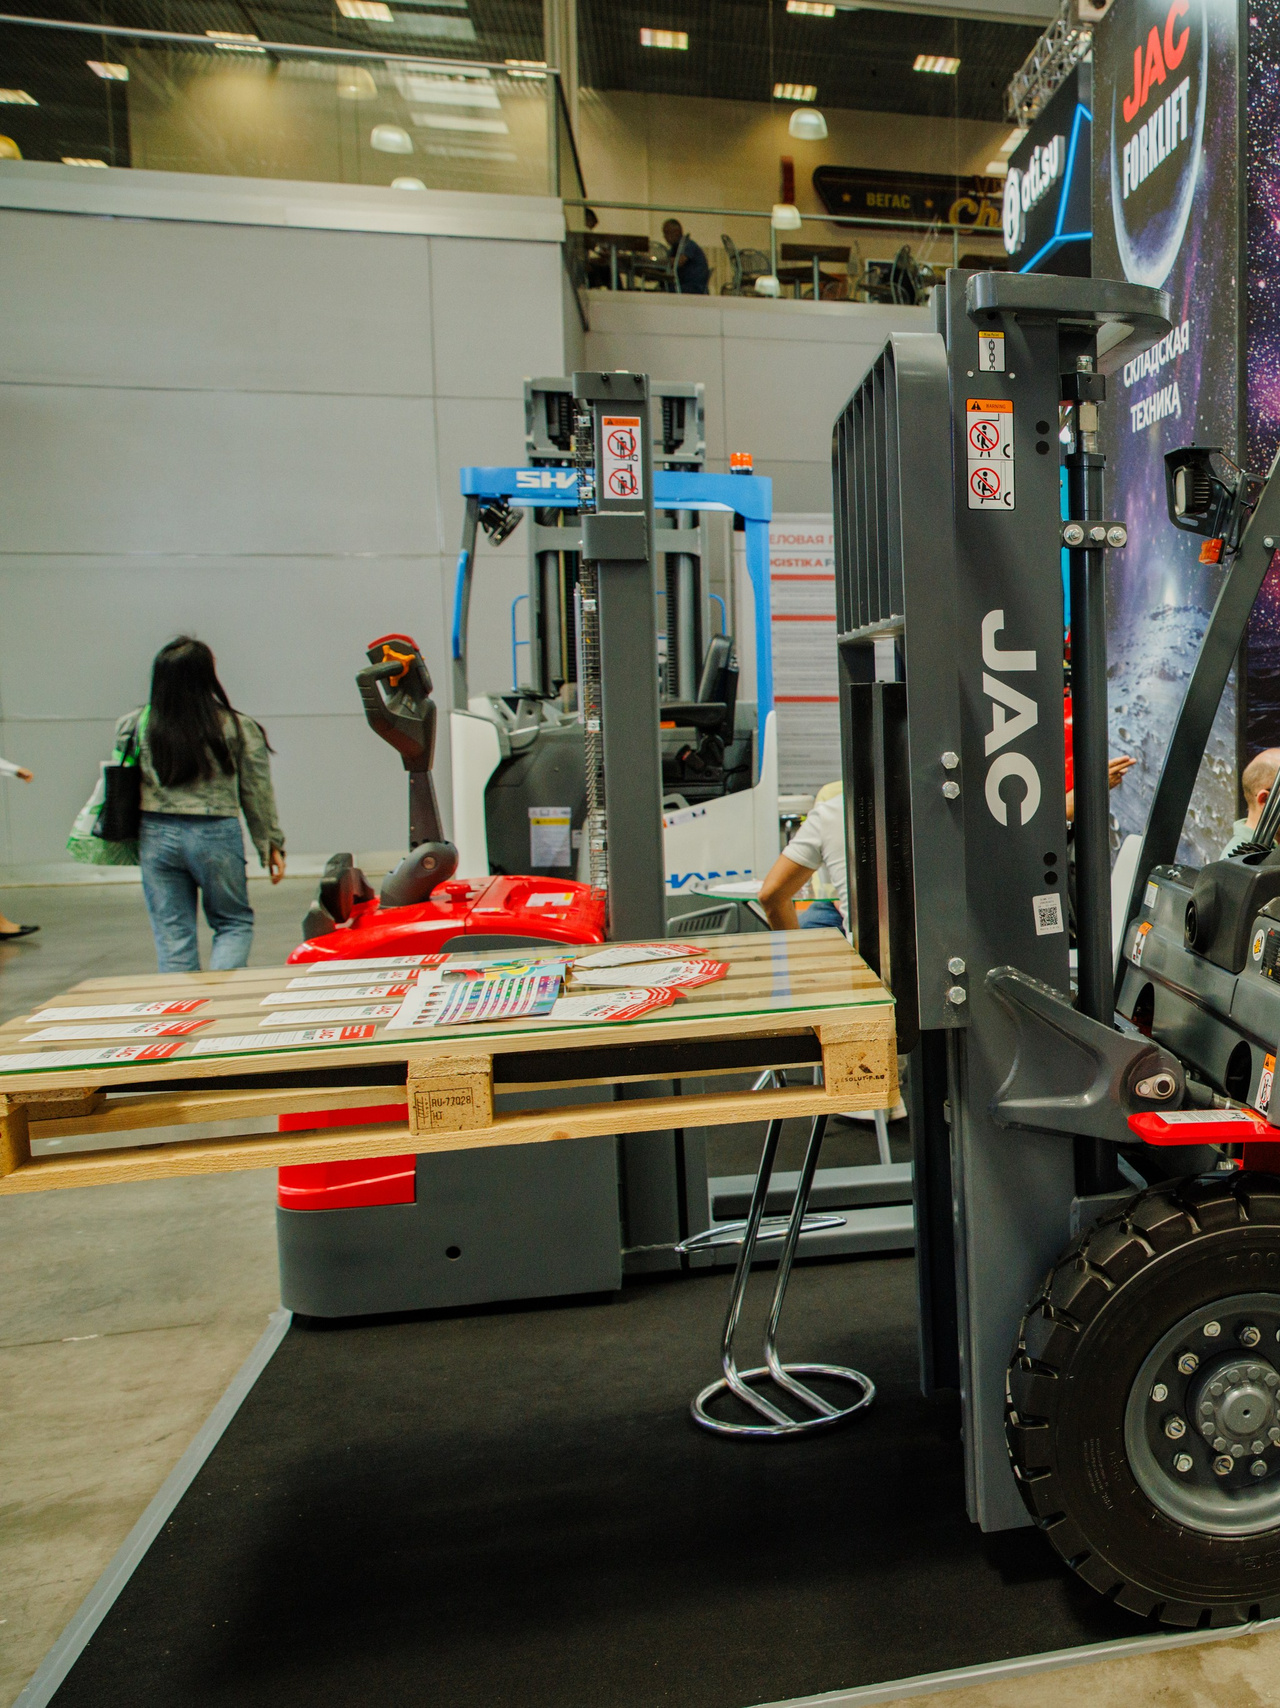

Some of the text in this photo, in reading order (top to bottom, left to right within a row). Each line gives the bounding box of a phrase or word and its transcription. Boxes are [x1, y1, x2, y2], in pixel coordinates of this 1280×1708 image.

[1123, 0, 1190, 123] JAC
[1123, 76, 1190, 200] FORKLIFT
[866, 192, 910, 209] ВЕГАС
[1021, 134, 1065, 213] ati.su
[1124, 320, 1189, 388] СКЛАДСКАЯ
[1130, 381, 1181, 433] ТЕХНИКА
[770, 534, 824, 545] ЕЛОВАЯ
[982, 609, 1041, 826] JAC
[432, 1095, 471, 1107] RU-77028
